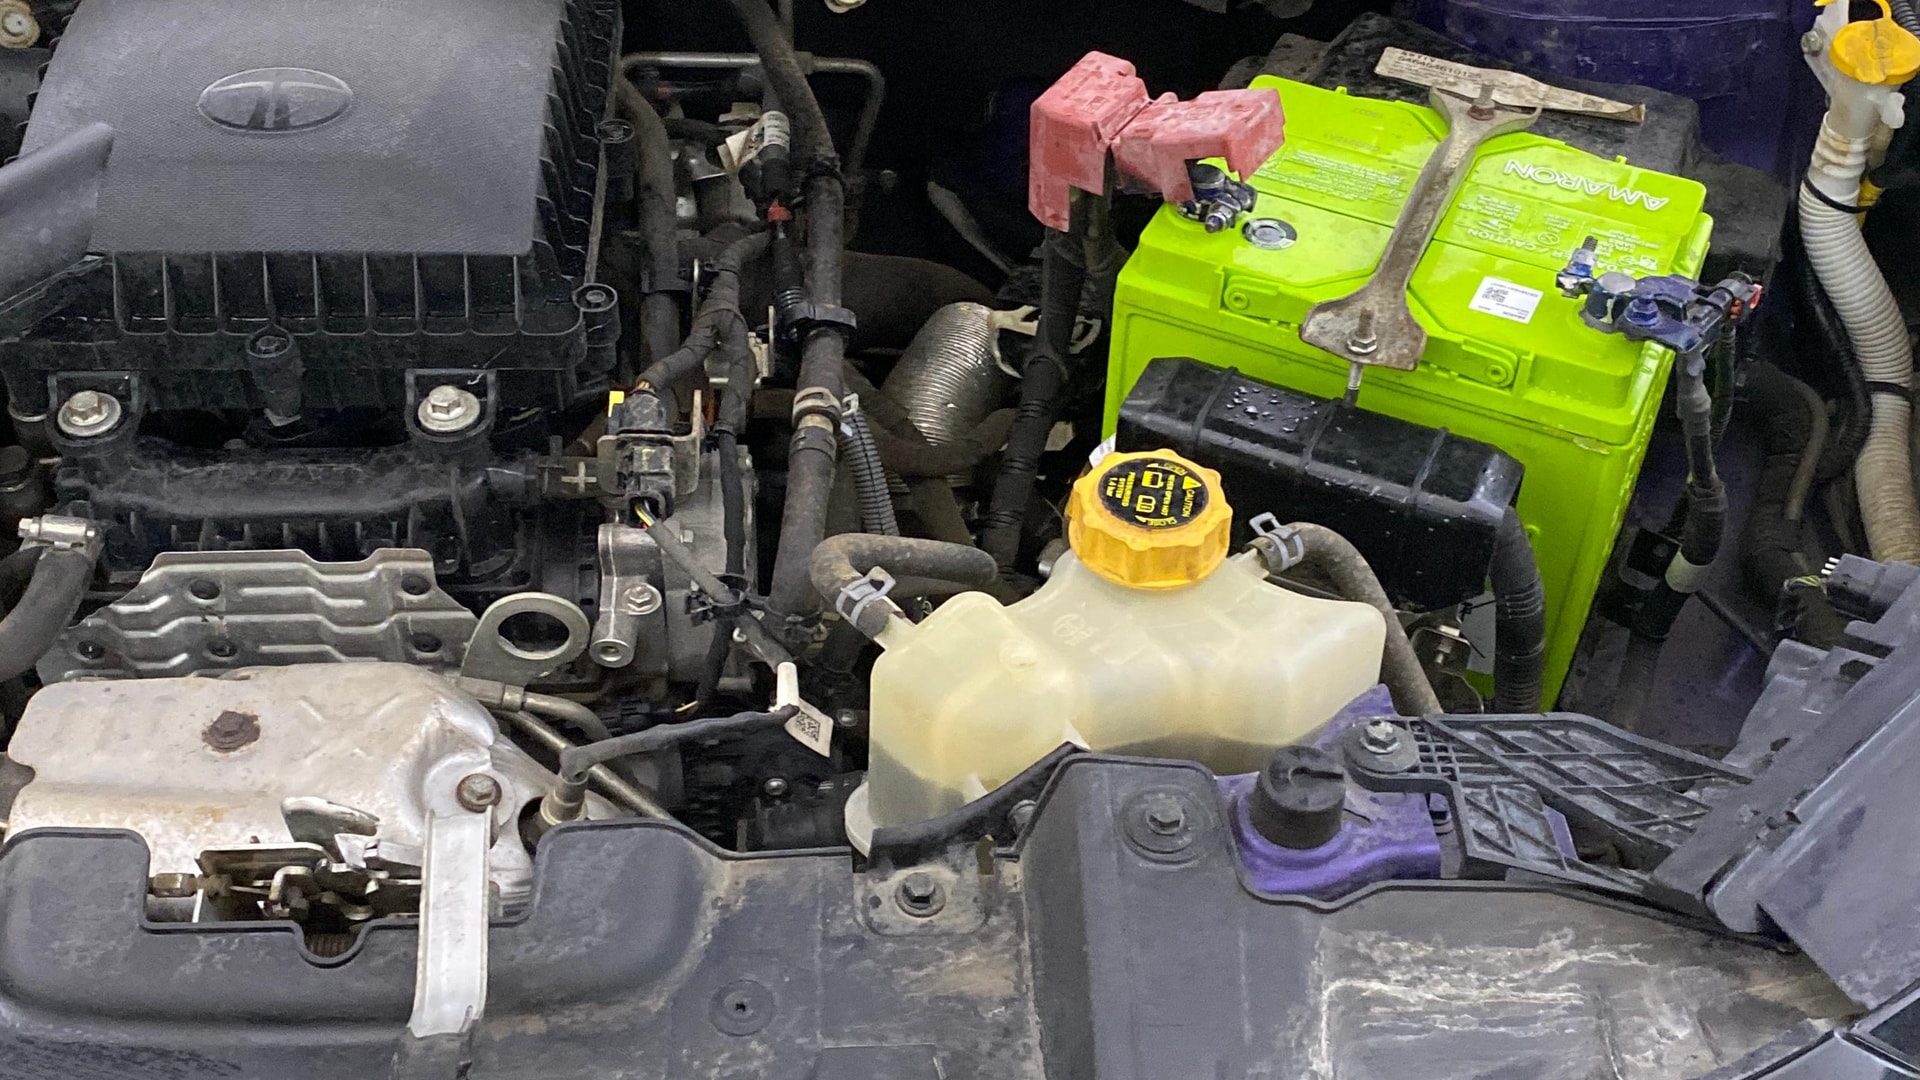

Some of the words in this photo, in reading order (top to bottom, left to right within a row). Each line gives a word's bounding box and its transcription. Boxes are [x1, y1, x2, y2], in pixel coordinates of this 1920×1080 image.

[1504, 160, 1670, 211] AMARON
[1467, 228, 1536, 250] CAUTION
[1181, 489, 1195, 518] CAUTION
